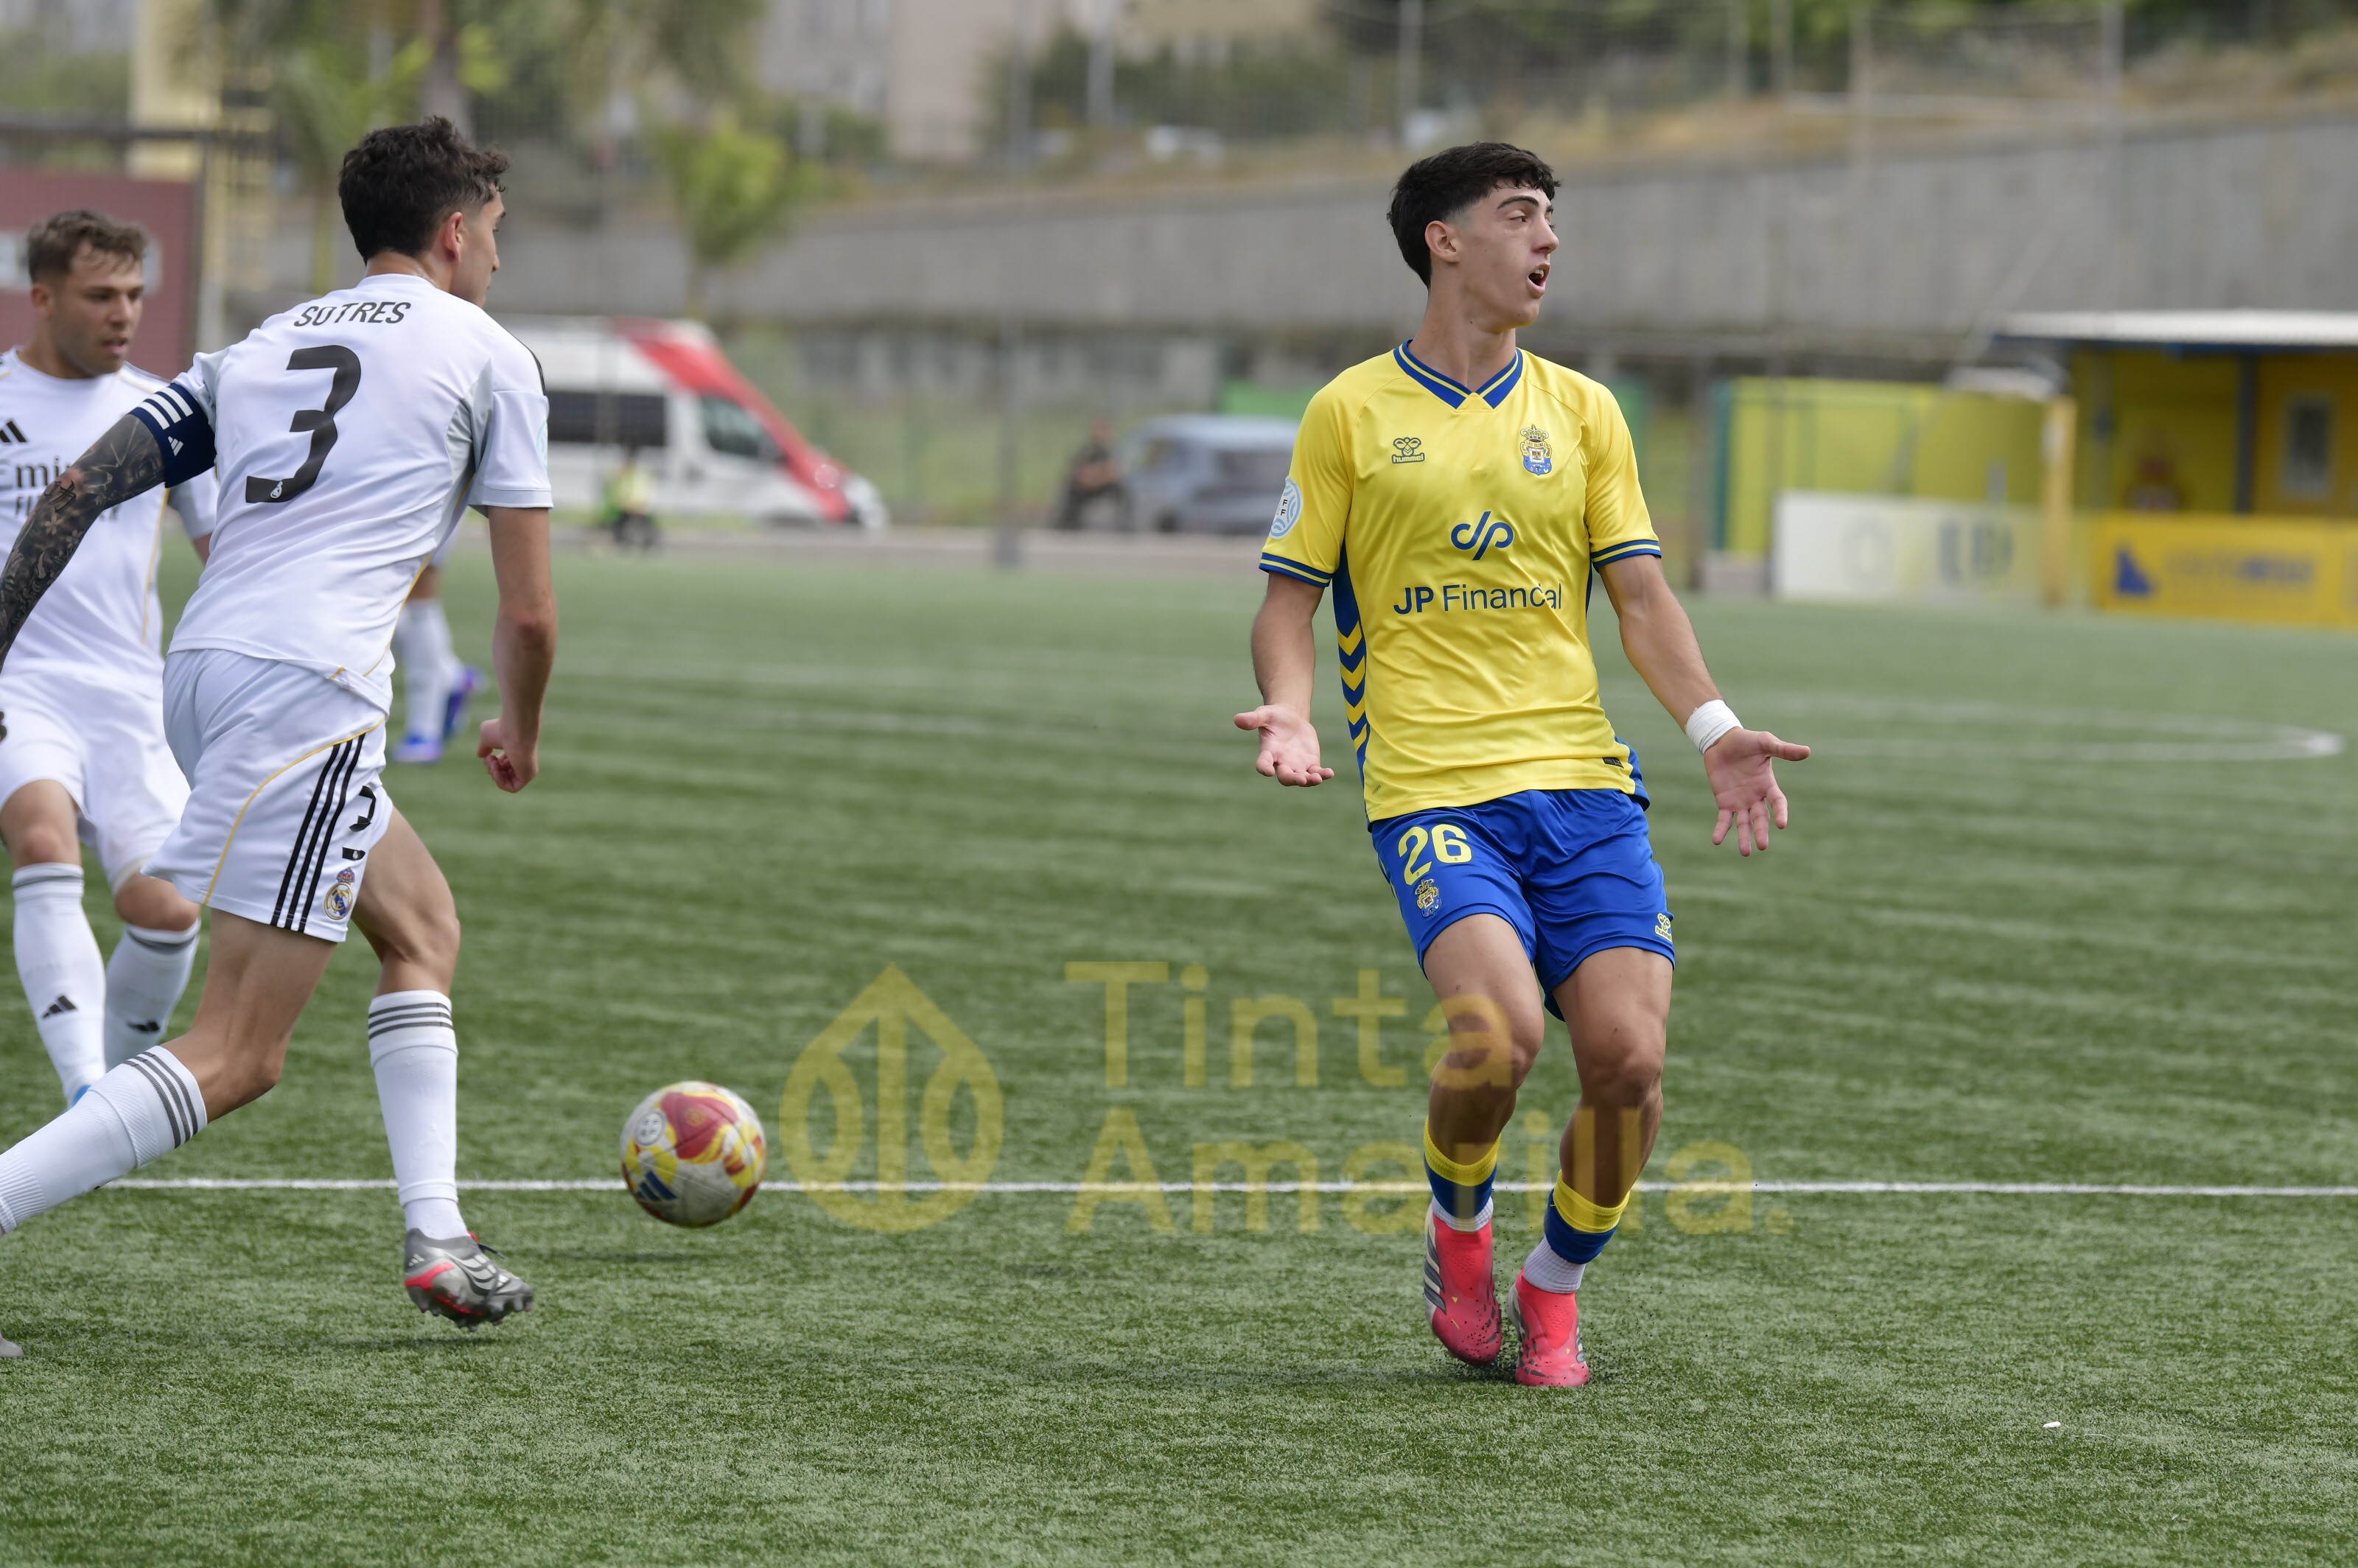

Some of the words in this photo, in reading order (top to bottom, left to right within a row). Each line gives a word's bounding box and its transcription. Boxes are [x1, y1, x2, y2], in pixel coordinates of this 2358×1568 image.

[293, 301, 411, 326] SOTRES
[245, 345, 361, 503] 3
[1392, 453, 1424, 463] hummel
[1393, 587, 1435, 615] JP
[1442, 583, 1562, 611] Financal
[1398, 824, 1472, 886] 26
